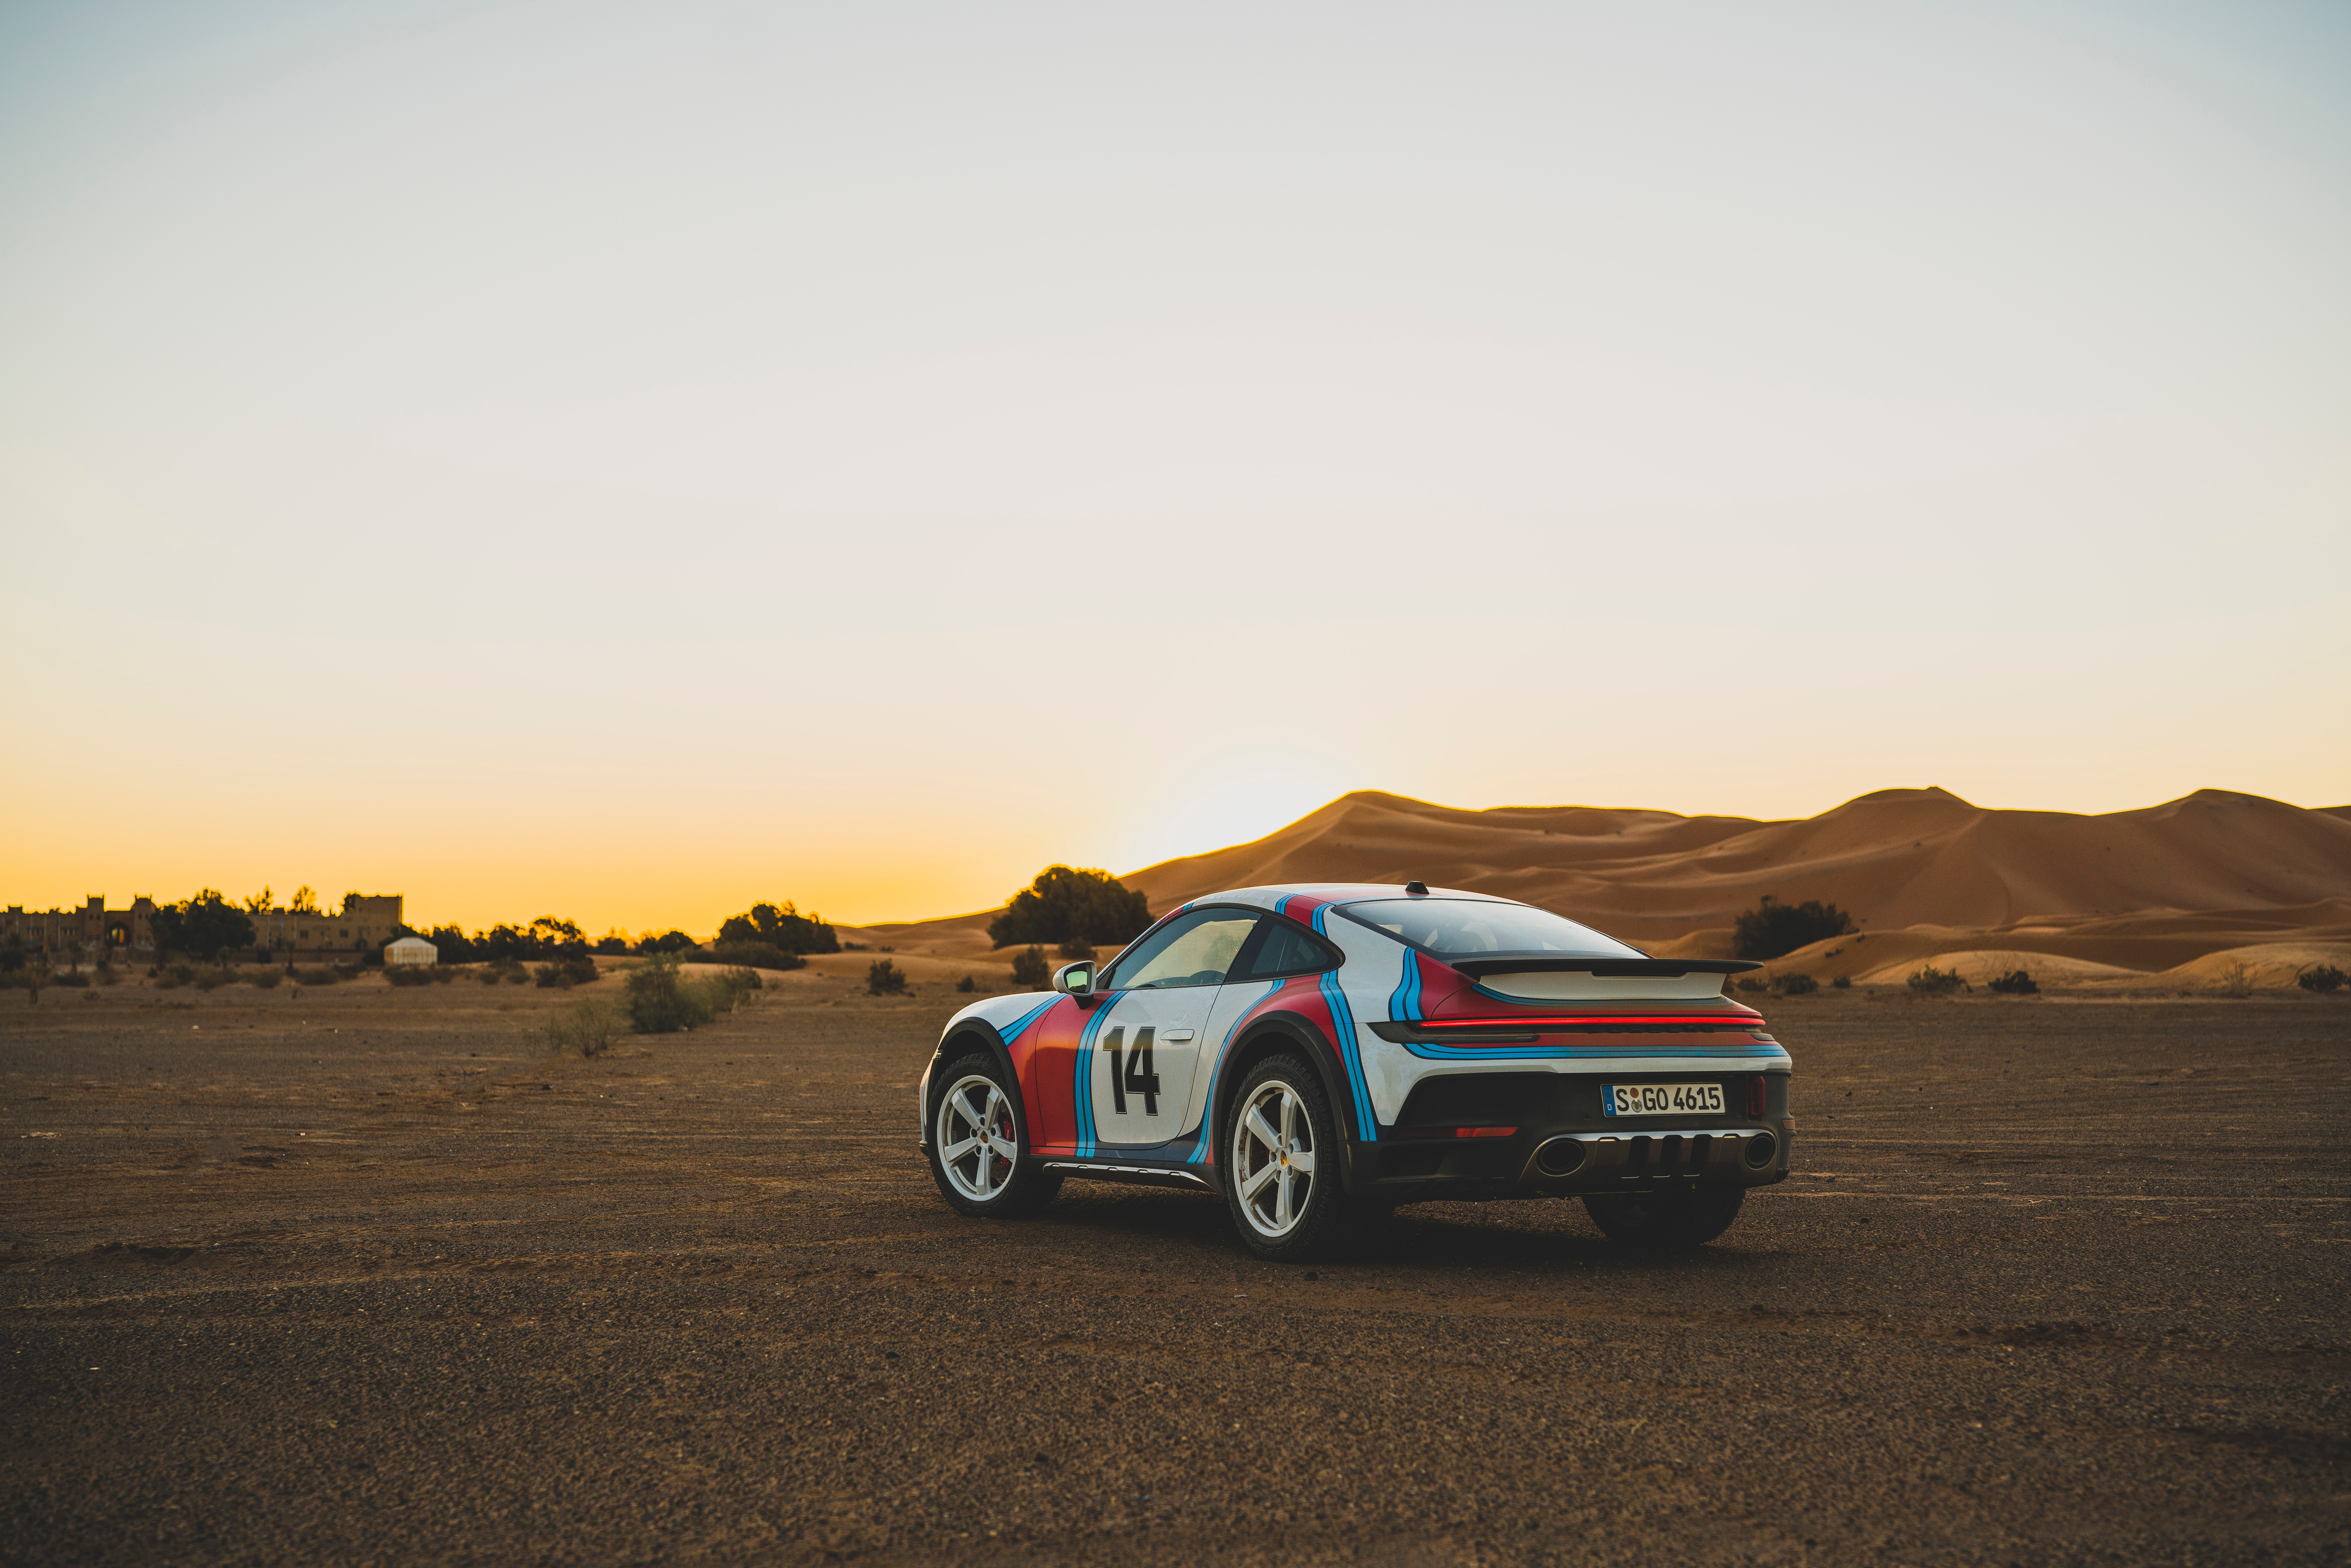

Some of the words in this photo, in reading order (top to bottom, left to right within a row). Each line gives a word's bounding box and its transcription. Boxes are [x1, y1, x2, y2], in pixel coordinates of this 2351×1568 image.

[1103, 1026, 1161, 1116] 14
[1616, 1088, 1629, 1112] S
[1642, 1087, 1669, 1111] GO
[1673, 1087, 1721, 1111] 4615
